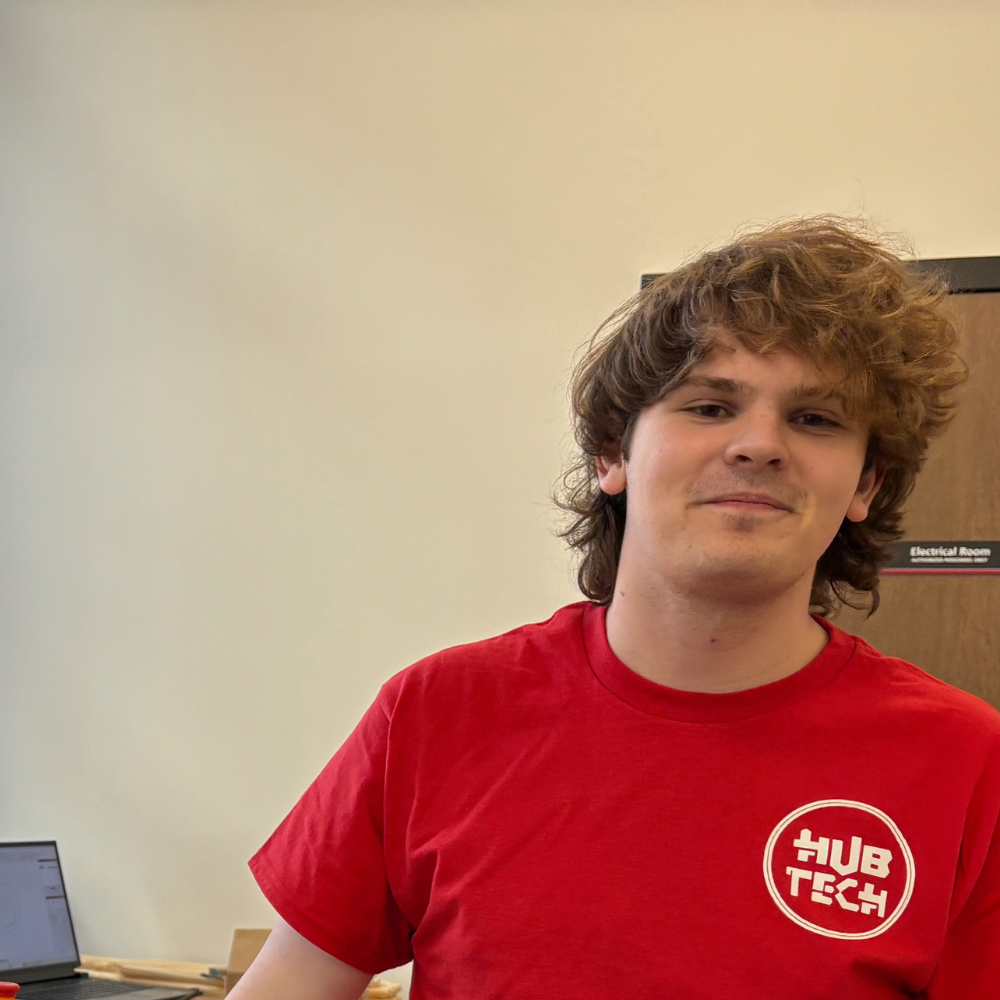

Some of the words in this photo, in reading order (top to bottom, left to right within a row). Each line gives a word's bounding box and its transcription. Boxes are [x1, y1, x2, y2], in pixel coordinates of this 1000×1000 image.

[909, 546, 958, 557] Electrical
[958, 546, 991, 557] Room
[793, 828, 893, 879] HUB
[785, 866, 888, 918] TECH
